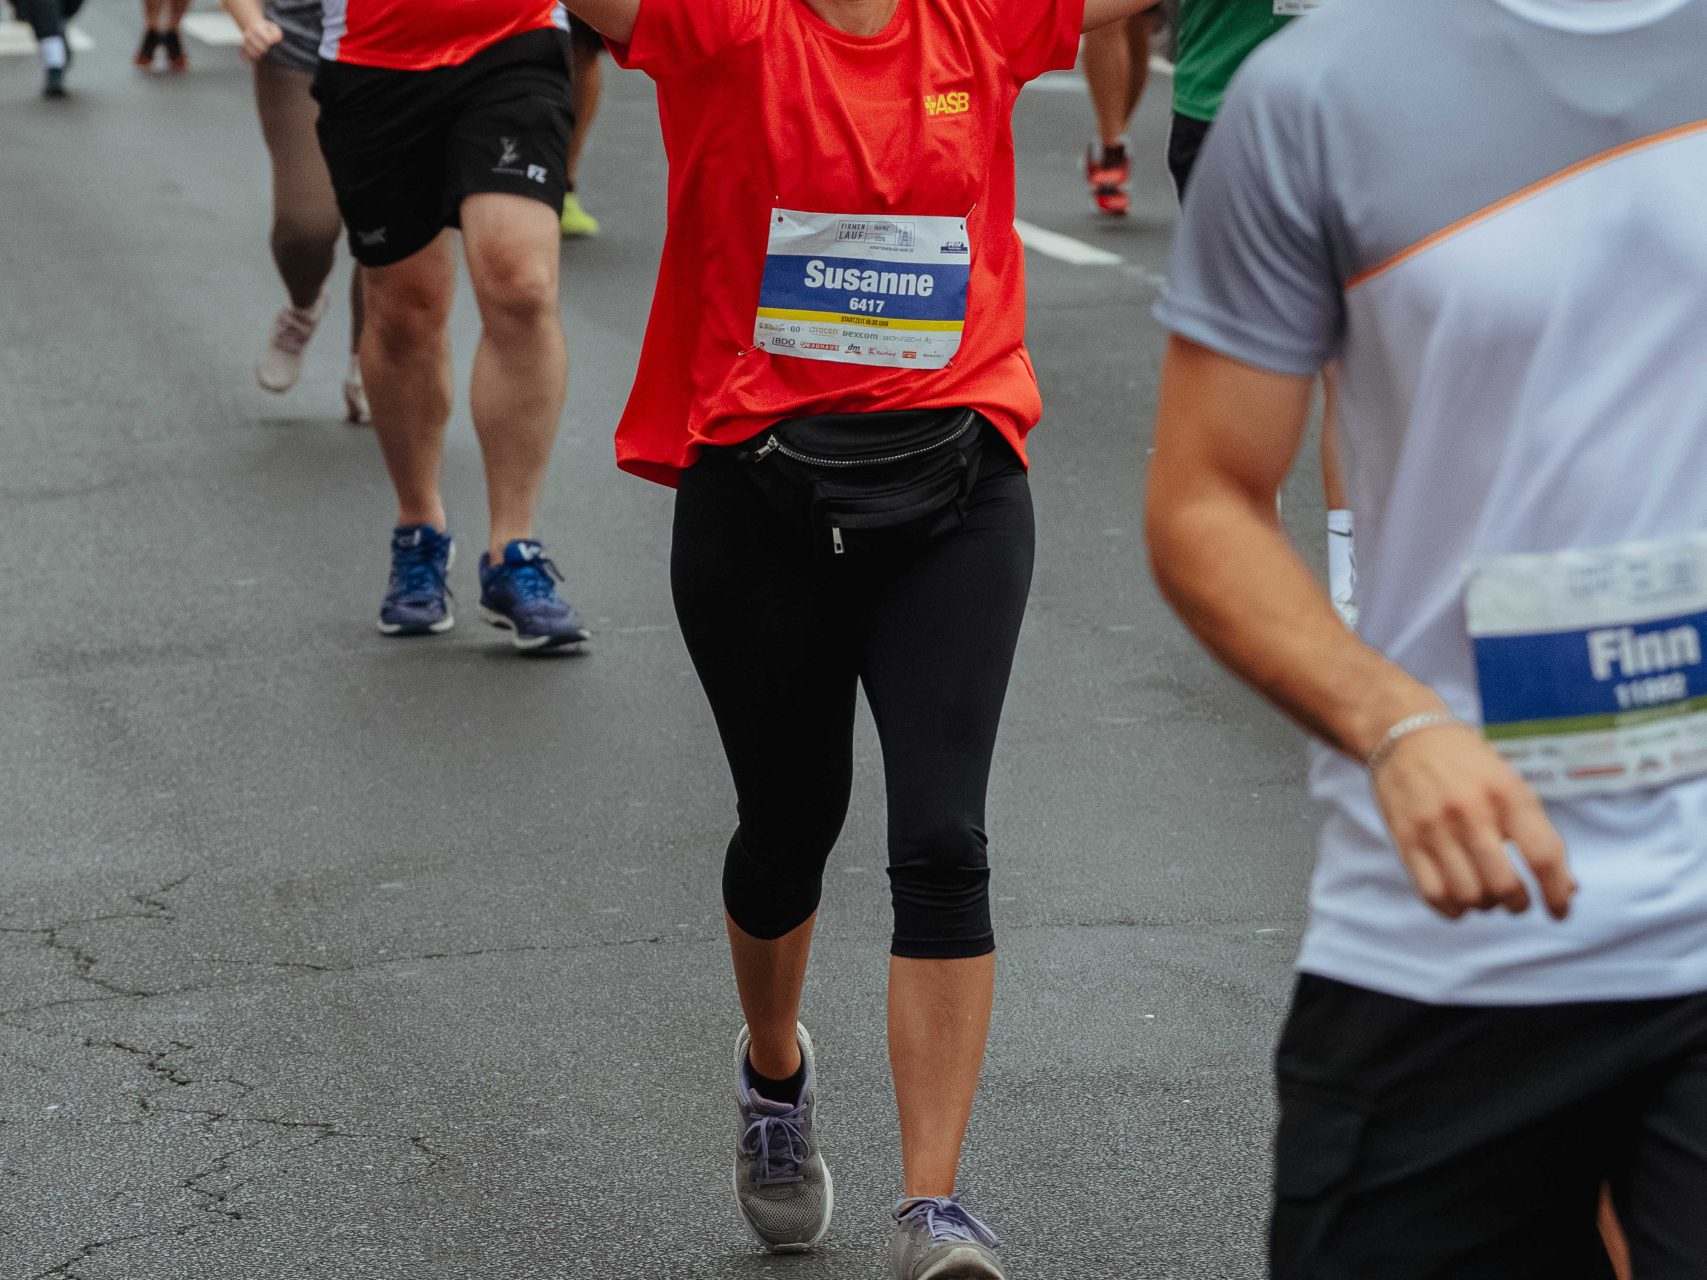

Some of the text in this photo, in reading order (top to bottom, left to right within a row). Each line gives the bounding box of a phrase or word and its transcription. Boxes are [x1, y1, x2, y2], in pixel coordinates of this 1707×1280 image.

[935, 91, 970, 115] ASB
[838, 231, 864, 241] LAUF
[840, 222, 866, 231] FIRMEN
[803, 260, 934, 297] Susanne
[849, 297, 886, 313] 6417
[1586, 624, 1702, 682] Finn
